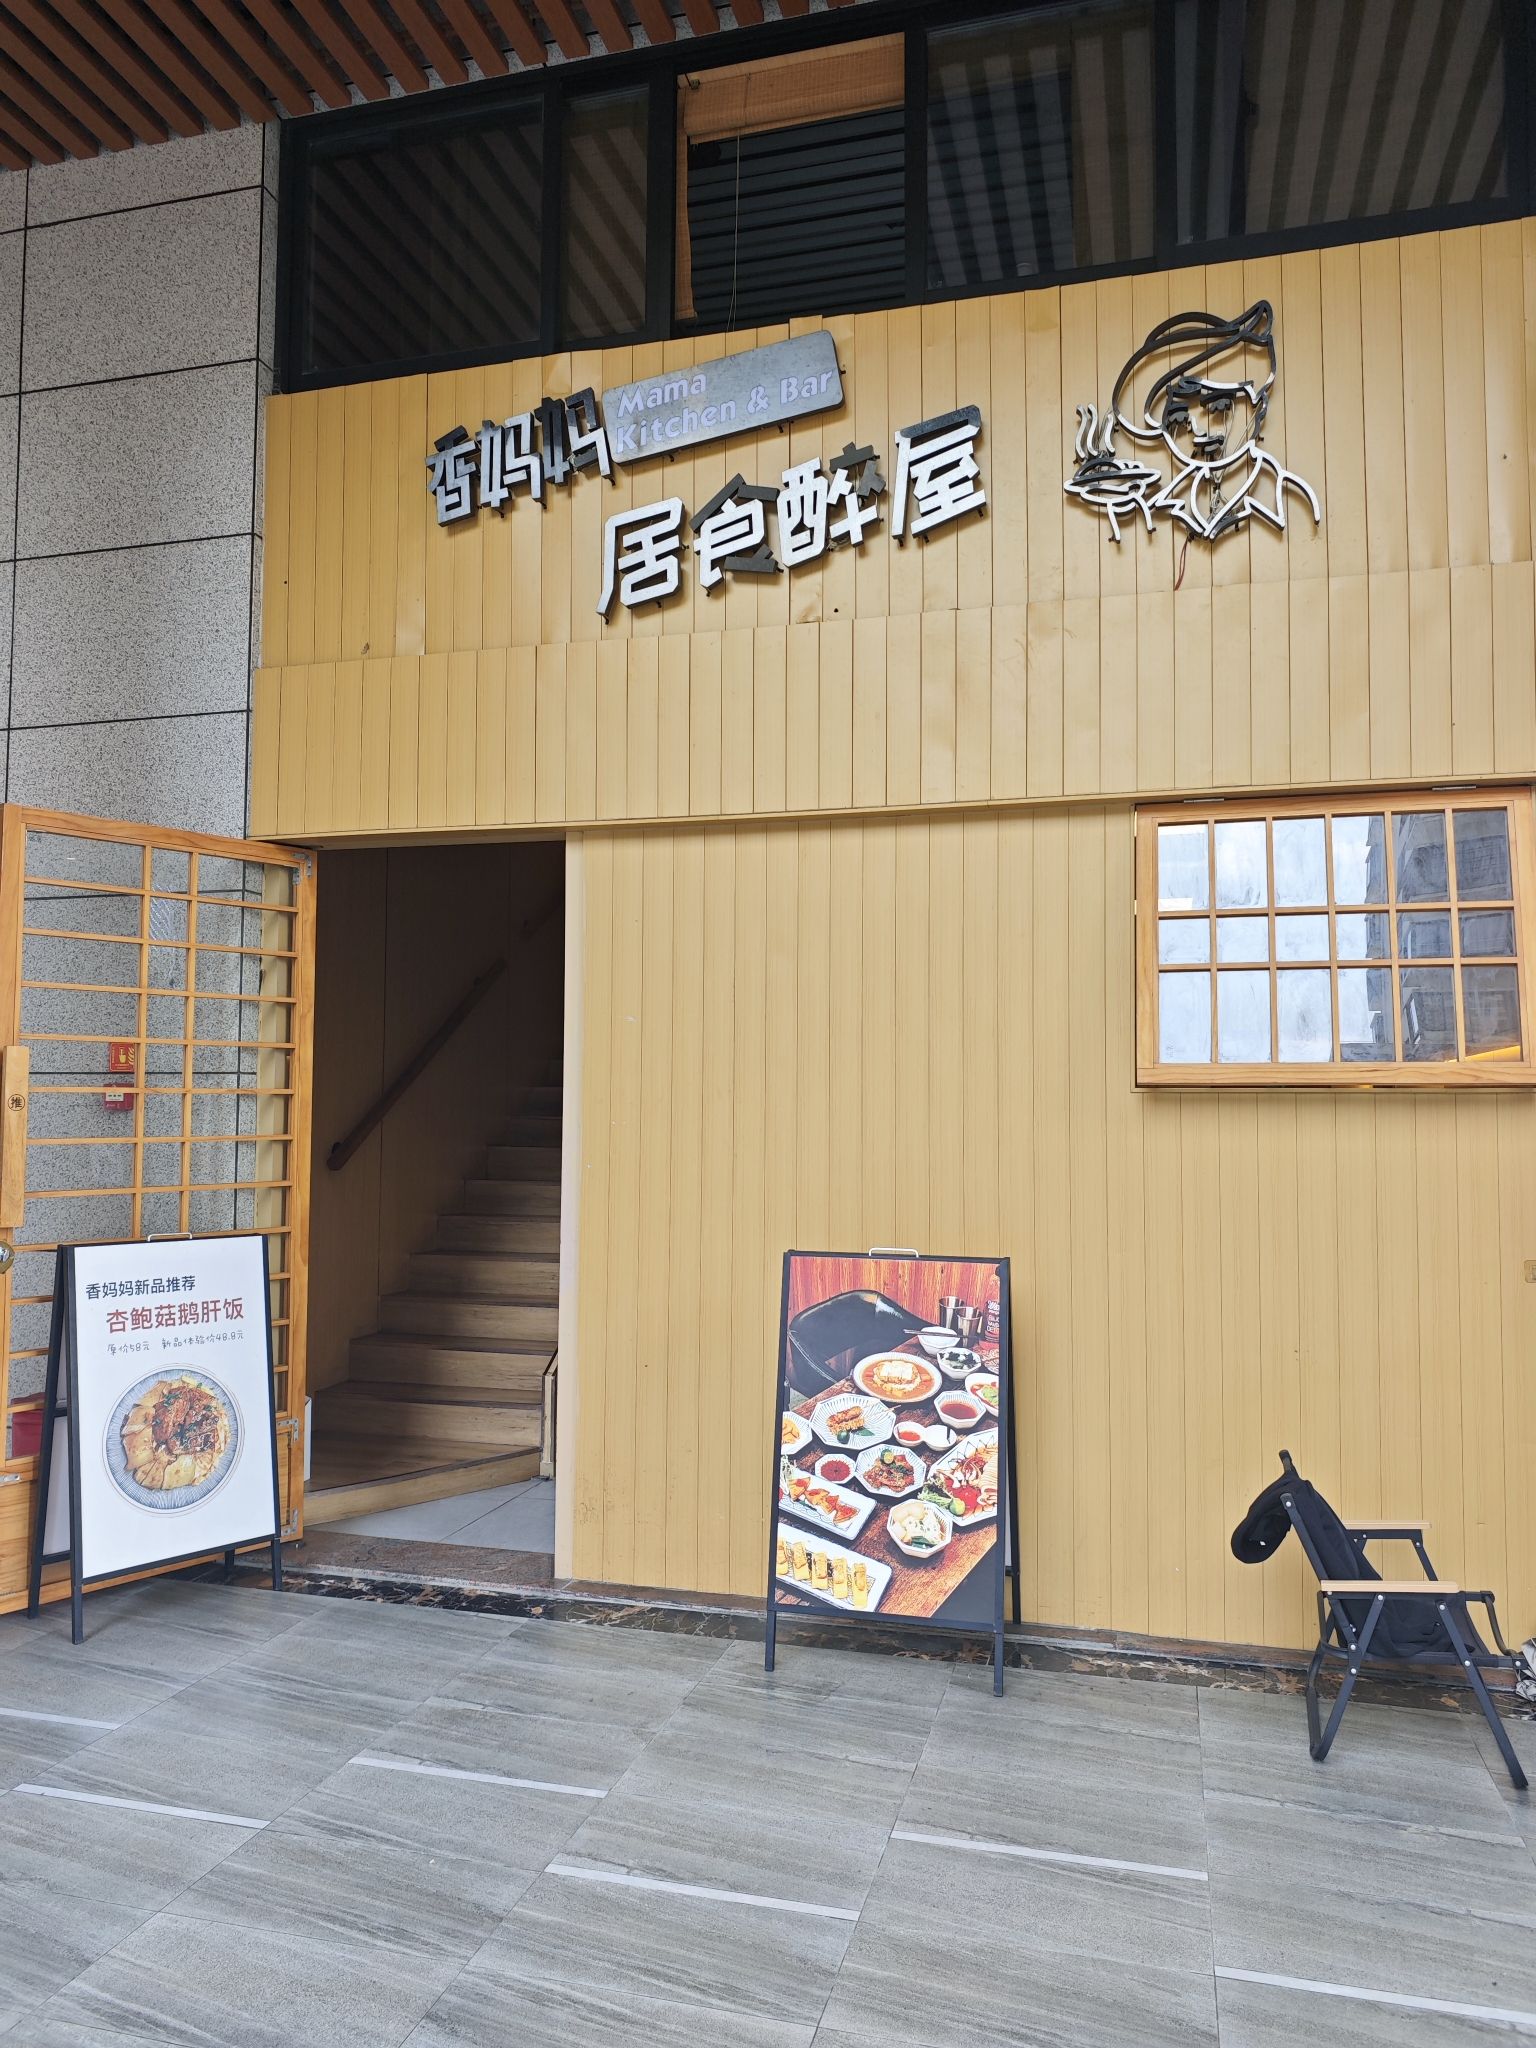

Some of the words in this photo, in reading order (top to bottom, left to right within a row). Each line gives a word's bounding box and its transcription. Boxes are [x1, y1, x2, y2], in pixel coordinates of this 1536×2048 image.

[616, 400, 736, 454] Kitchen
[746, 384, 770, 414] &
[780, 370, 833, 404] Bar
[617, 373, 707, 418] Mama
[425, 387, 614, 527] 香妈妈
[596, 404, 986, 618] 居食醉屋
[10, 1097, 23, 1109] 推
[86, 1275, 196, 1299] 香妈妈新品推荐
[106, 1297, 244, 1334] 杏鲍菇鹅肝饭
[107, 1341, 150, 1356] 原价58元
[161, 1330, 244, 1350] 新品体验价48.8元
